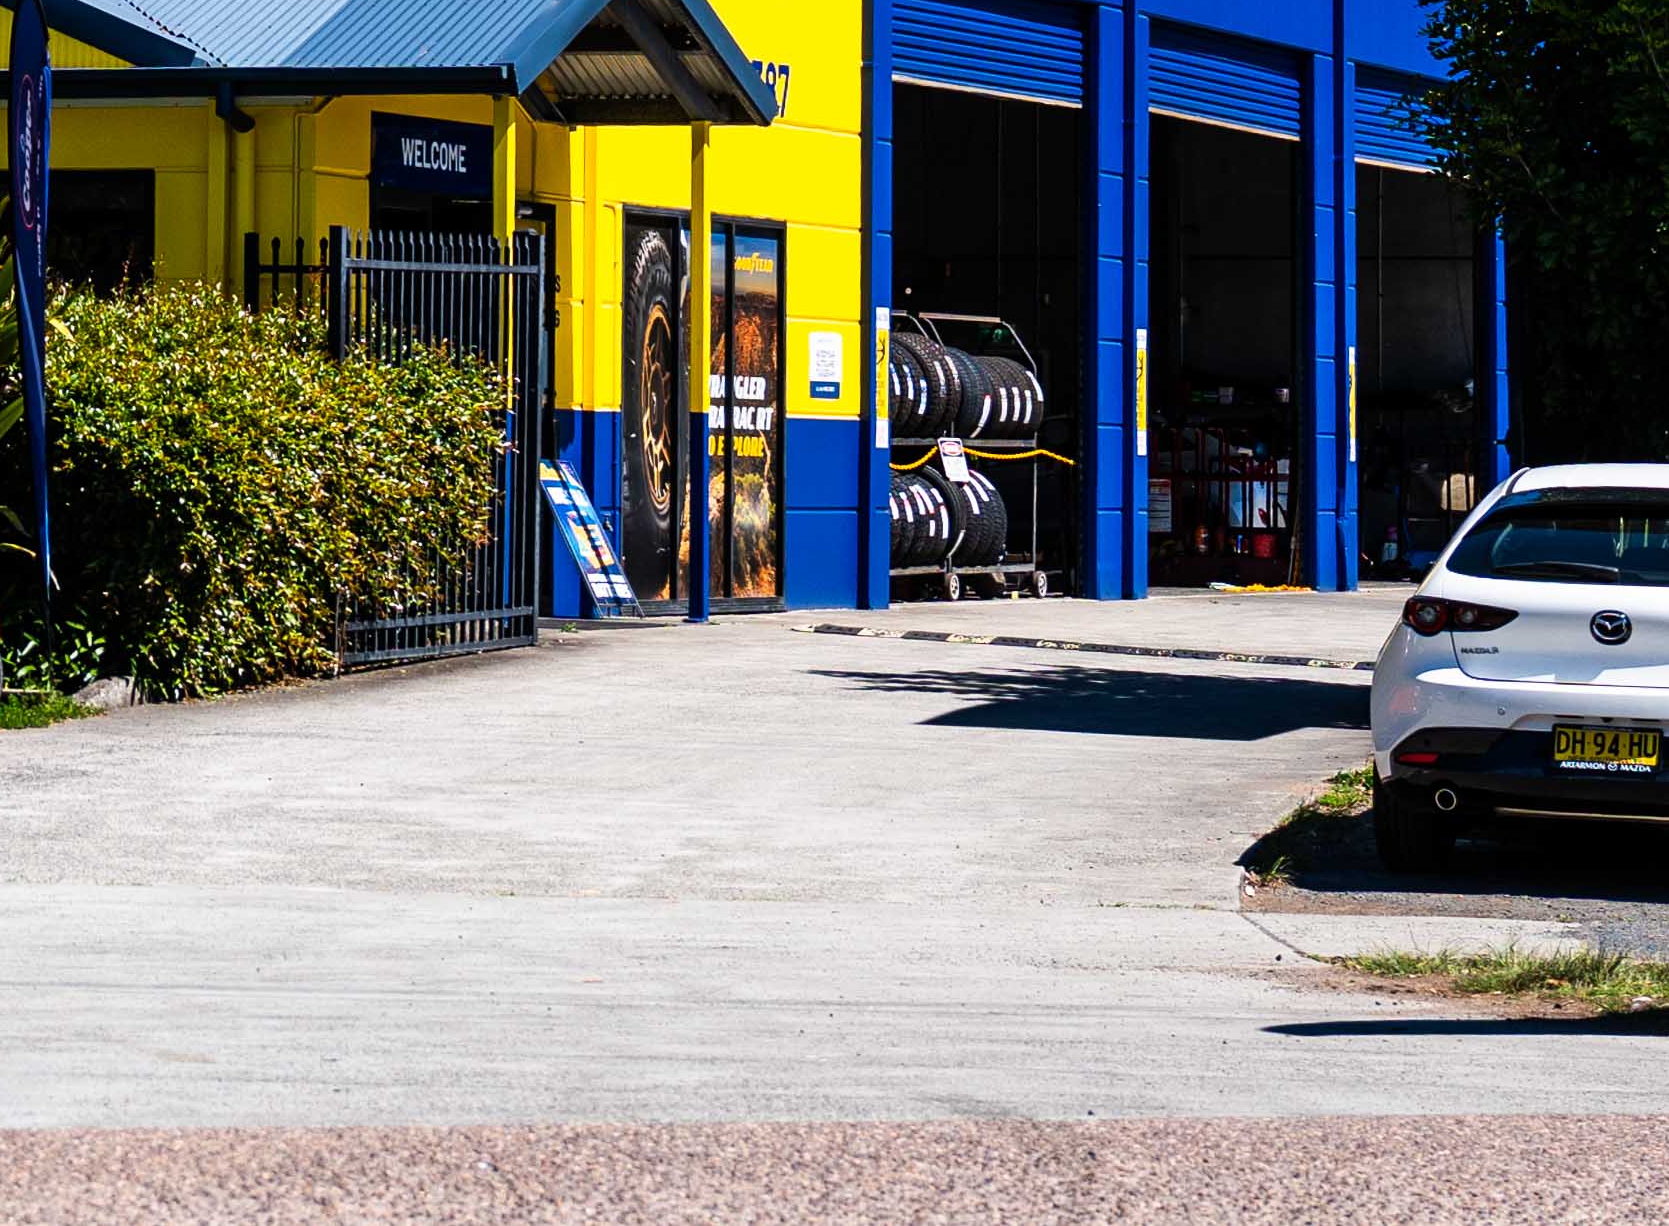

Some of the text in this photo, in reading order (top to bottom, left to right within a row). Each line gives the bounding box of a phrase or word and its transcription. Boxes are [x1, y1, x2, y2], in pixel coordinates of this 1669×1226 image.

[401, 137, 467, 173] WELCOME
[717, 434, 764, 457] EPLORE
[1620, 763, 1652, 773] MAZDA
